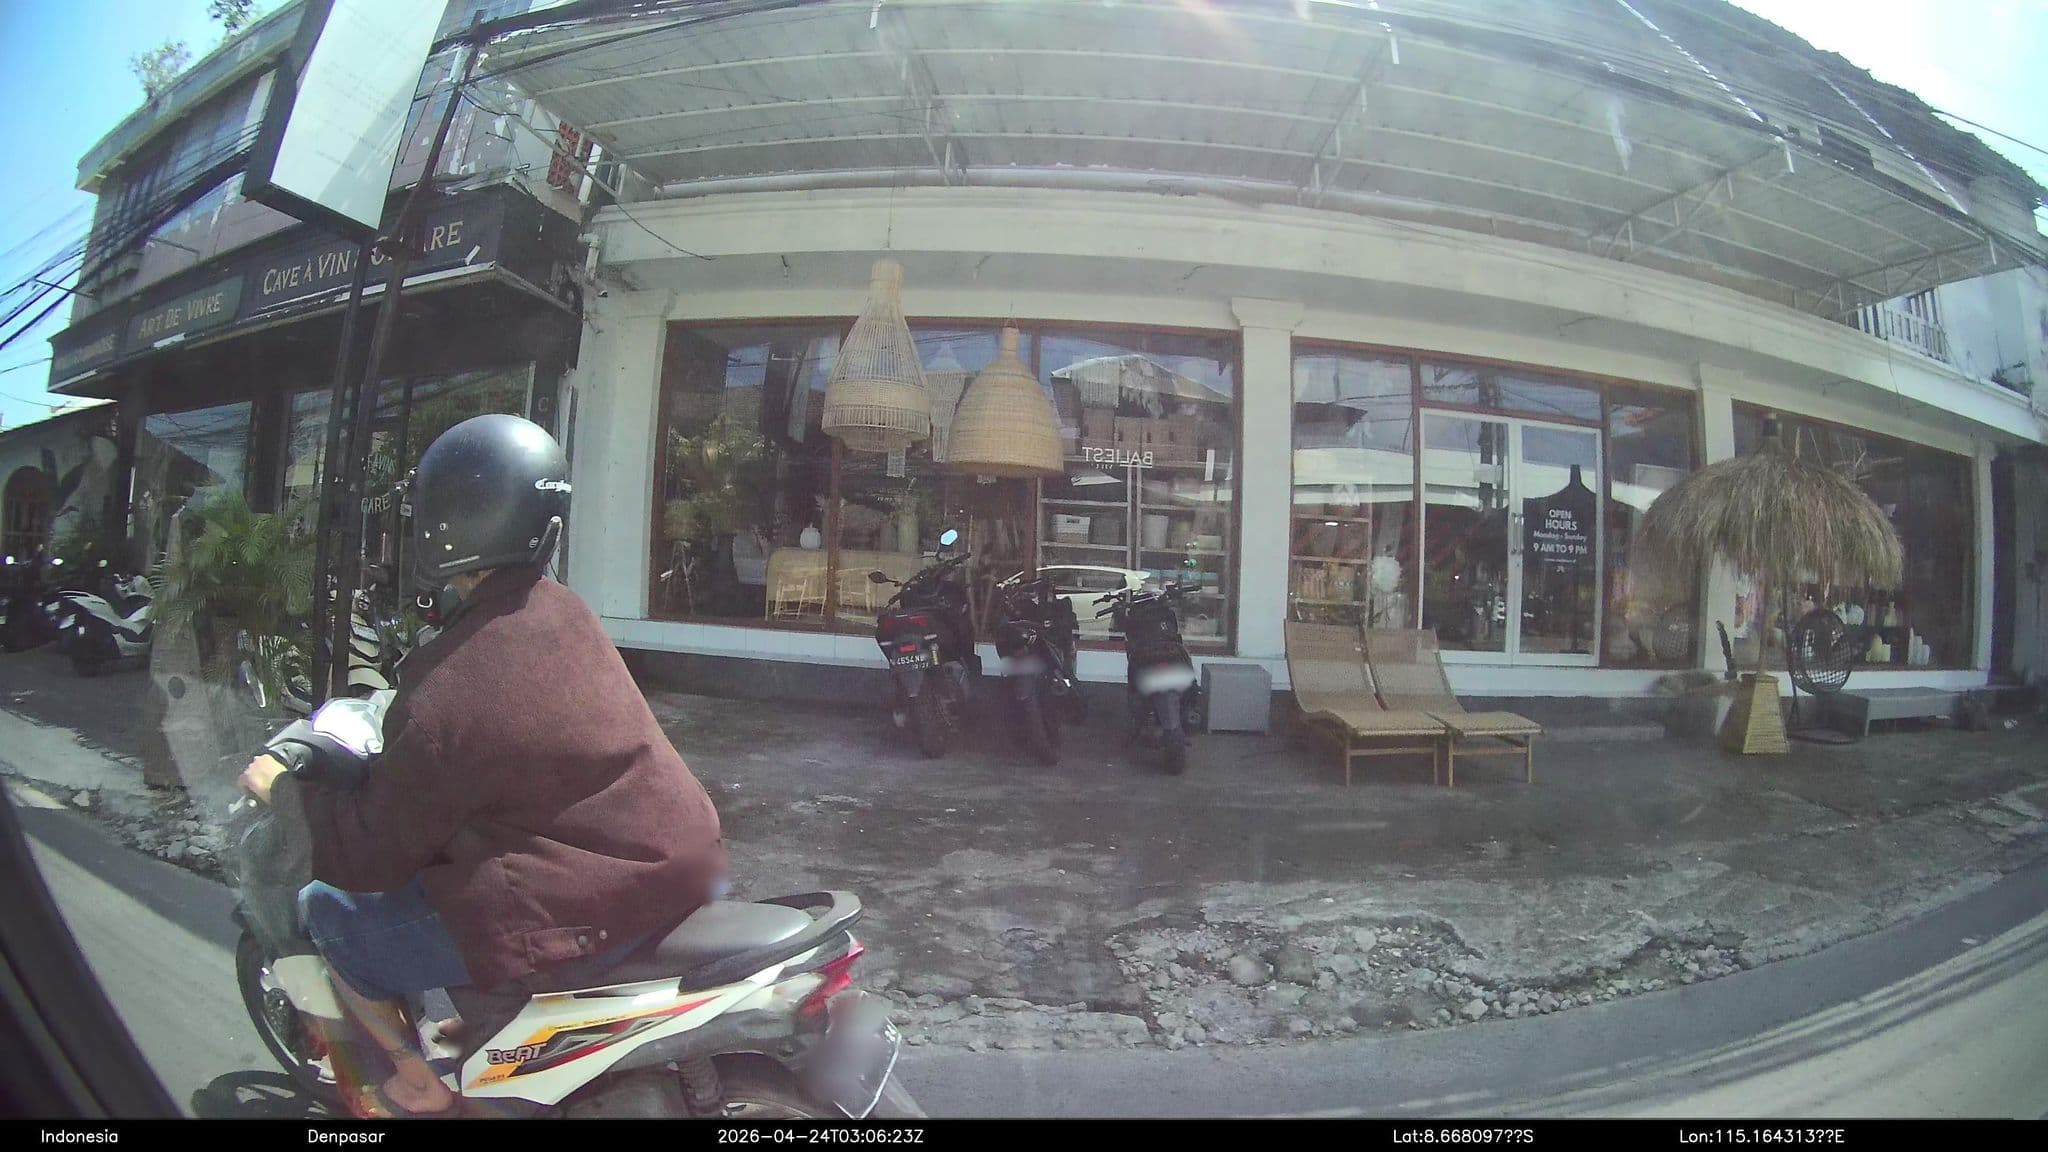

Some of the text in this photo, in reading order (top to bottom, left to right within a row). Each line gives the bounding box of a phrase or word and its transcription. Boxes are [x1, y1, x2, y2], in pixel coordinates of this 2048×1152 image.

[263, 265, 301, 295] CAVE
[318, 250, 350, 279] VIN
[139, 292, 224, 338] ART DE VIVRE
[1549, 509, 1572, 520] OPEN
[1545, 519, 1577, 531] HOURS
[1533, 530, 1560, 541] Monday
[1564, 532, 1587, 543] Sunday
[1533, 542, 1588, 555] 9 AM TO 9 PM
